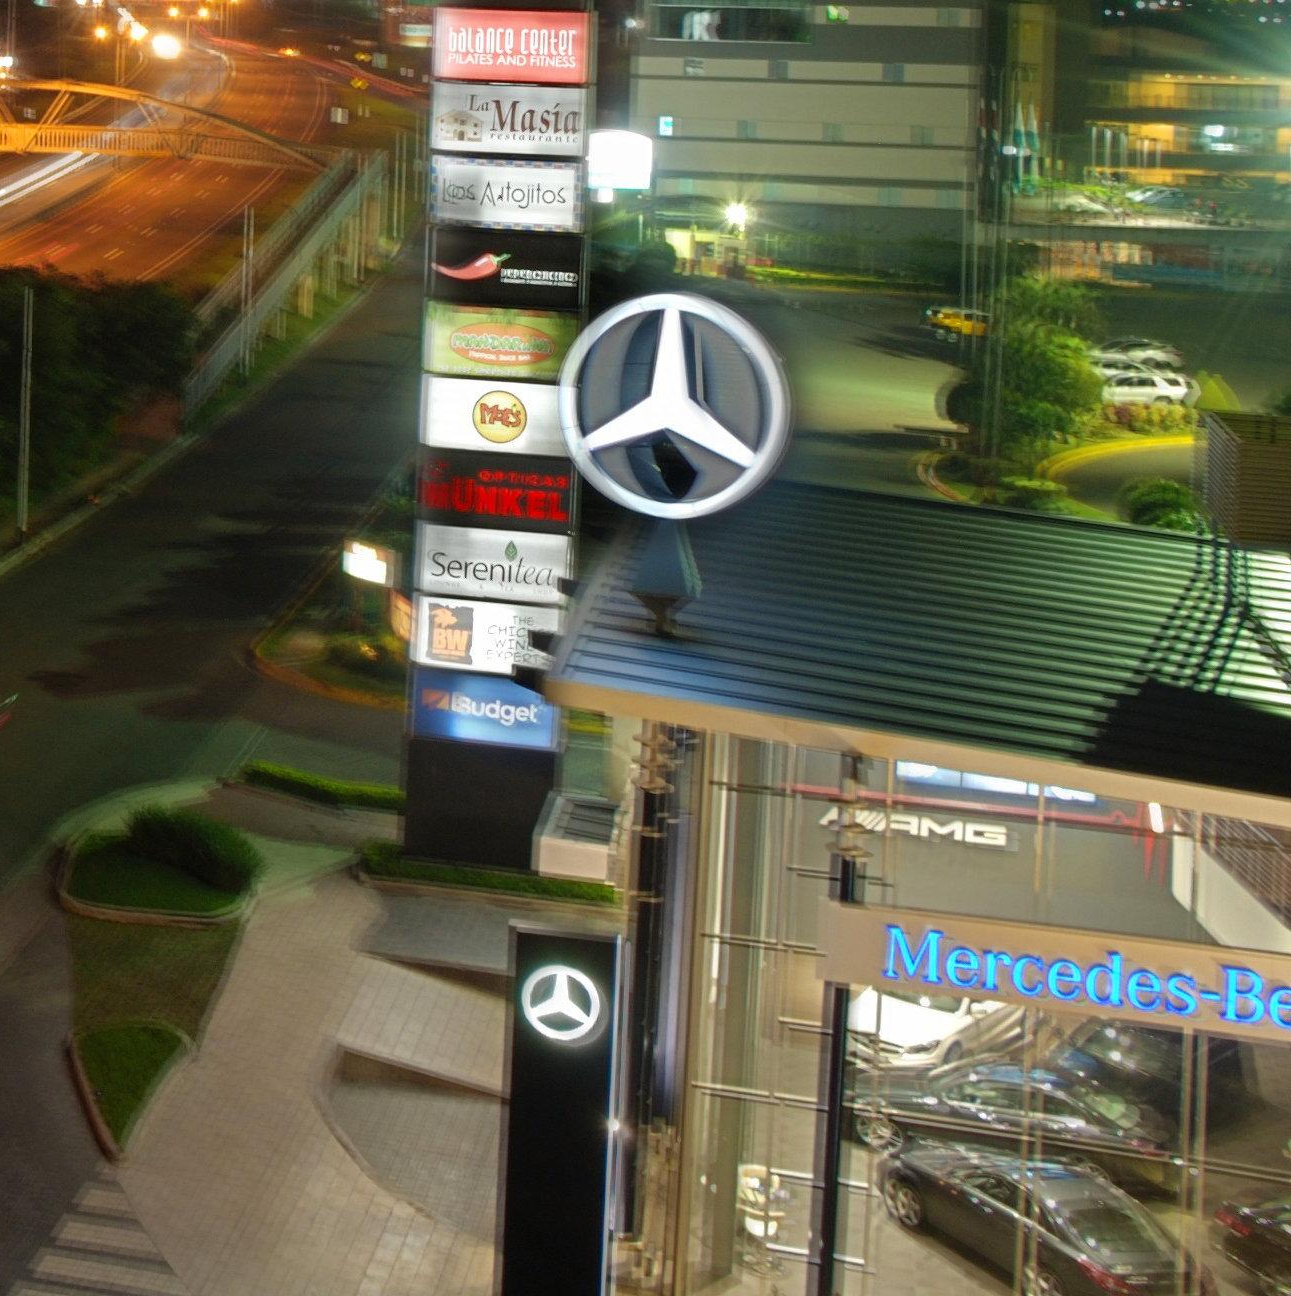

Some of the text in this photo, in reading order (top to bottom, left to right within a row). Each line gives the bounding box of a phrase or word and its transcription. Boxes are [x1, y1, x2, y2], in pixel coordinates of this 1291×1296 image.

[448, 26, 513, 55] balance
[520, 28, 577, 56] center
[448, 54, 576, 68] PILATES AND FITNESS
[468, 93, 580, 135] La Masía
[489, 132, 578, 144] restaurante
[430, 551, 553, 586] Serenitea
[487, 624, 527, 638] CHIC
[513, 615, 534, 626] THE
[433, 628, 469, 650] BW
[451, 691, 538, 726] Budget
